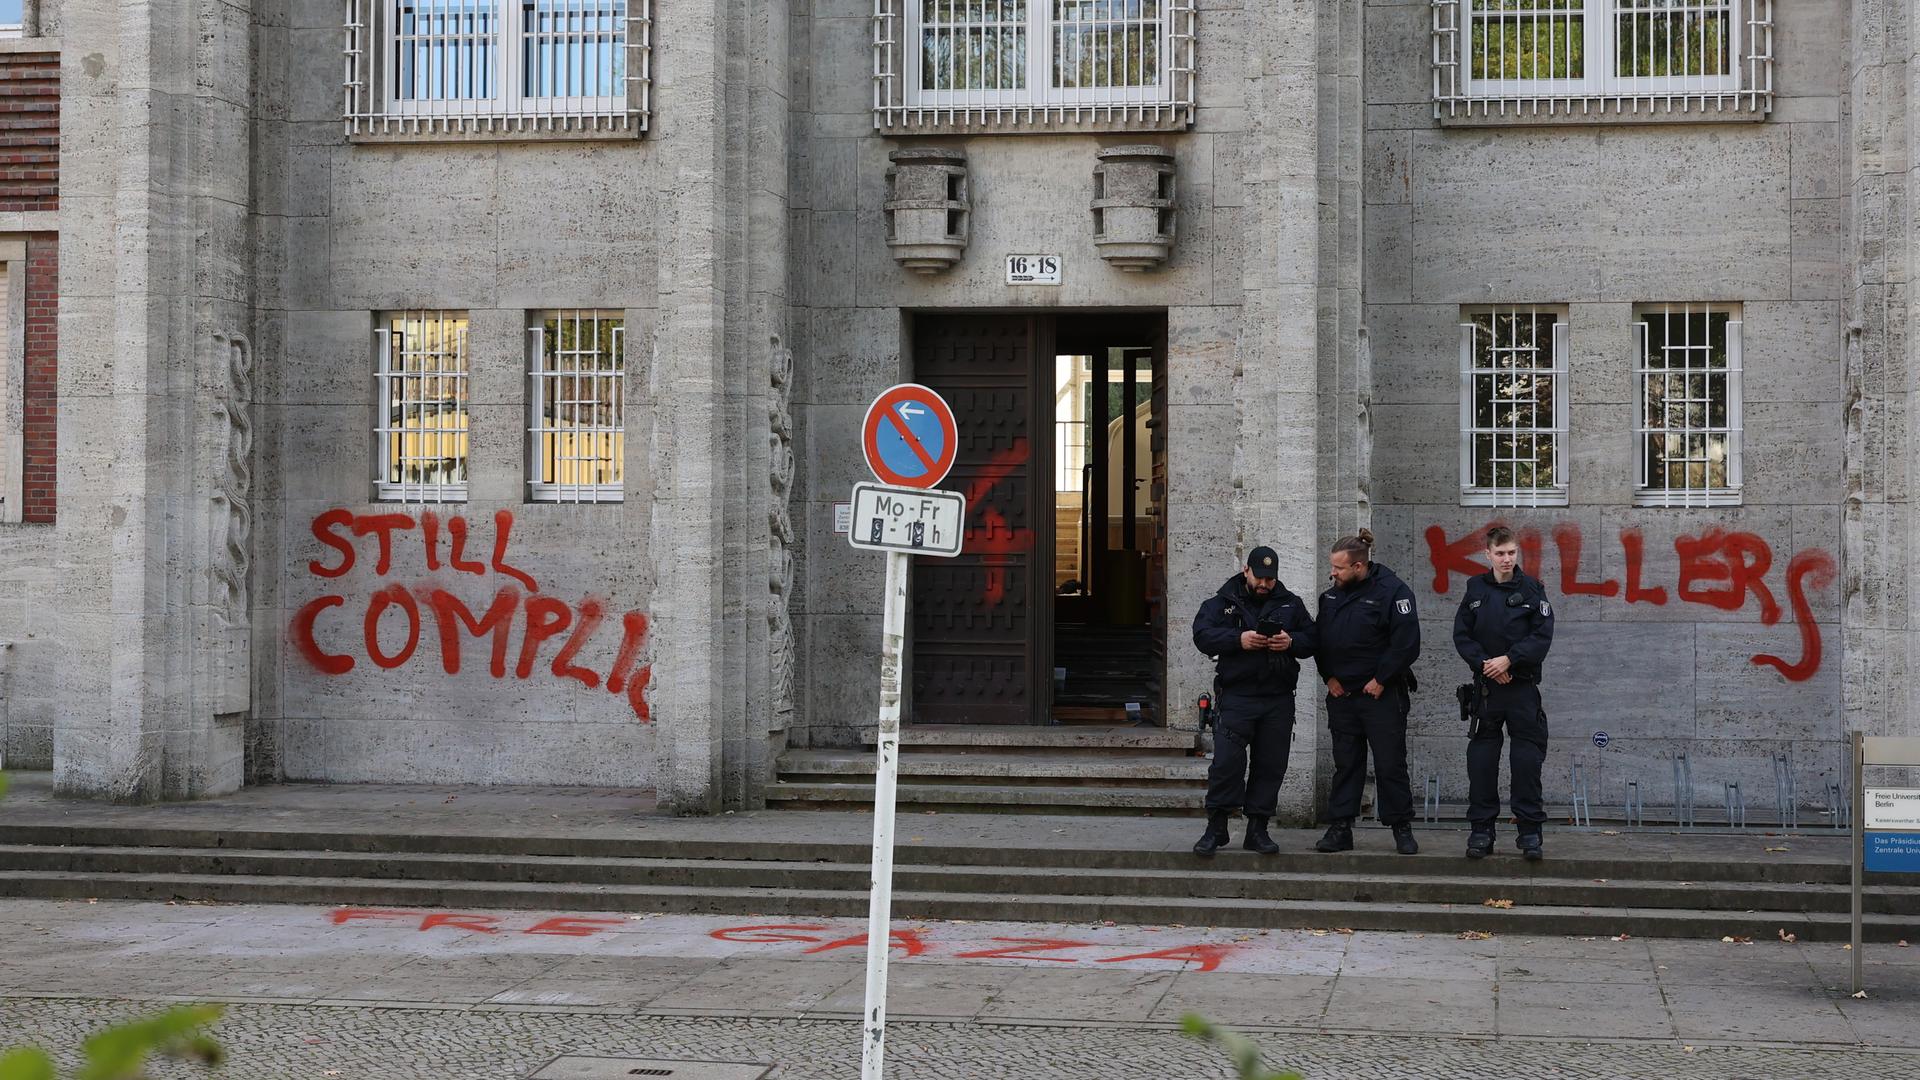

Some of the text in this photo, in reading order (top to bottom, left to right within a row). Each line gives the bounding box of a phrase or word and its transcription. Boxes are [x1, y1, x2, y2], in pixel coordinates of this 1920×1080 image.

[308, 508, 540, 593] STILL
[1423, 520, 1838, 683] KILLERS
[1875, 792, 1891, 800] Freie
[1875, 800, 1895, 808] Berlin
[1874, 846, 1904, 854] Zentrale
[708, 924, 1236, 972] GAZA
